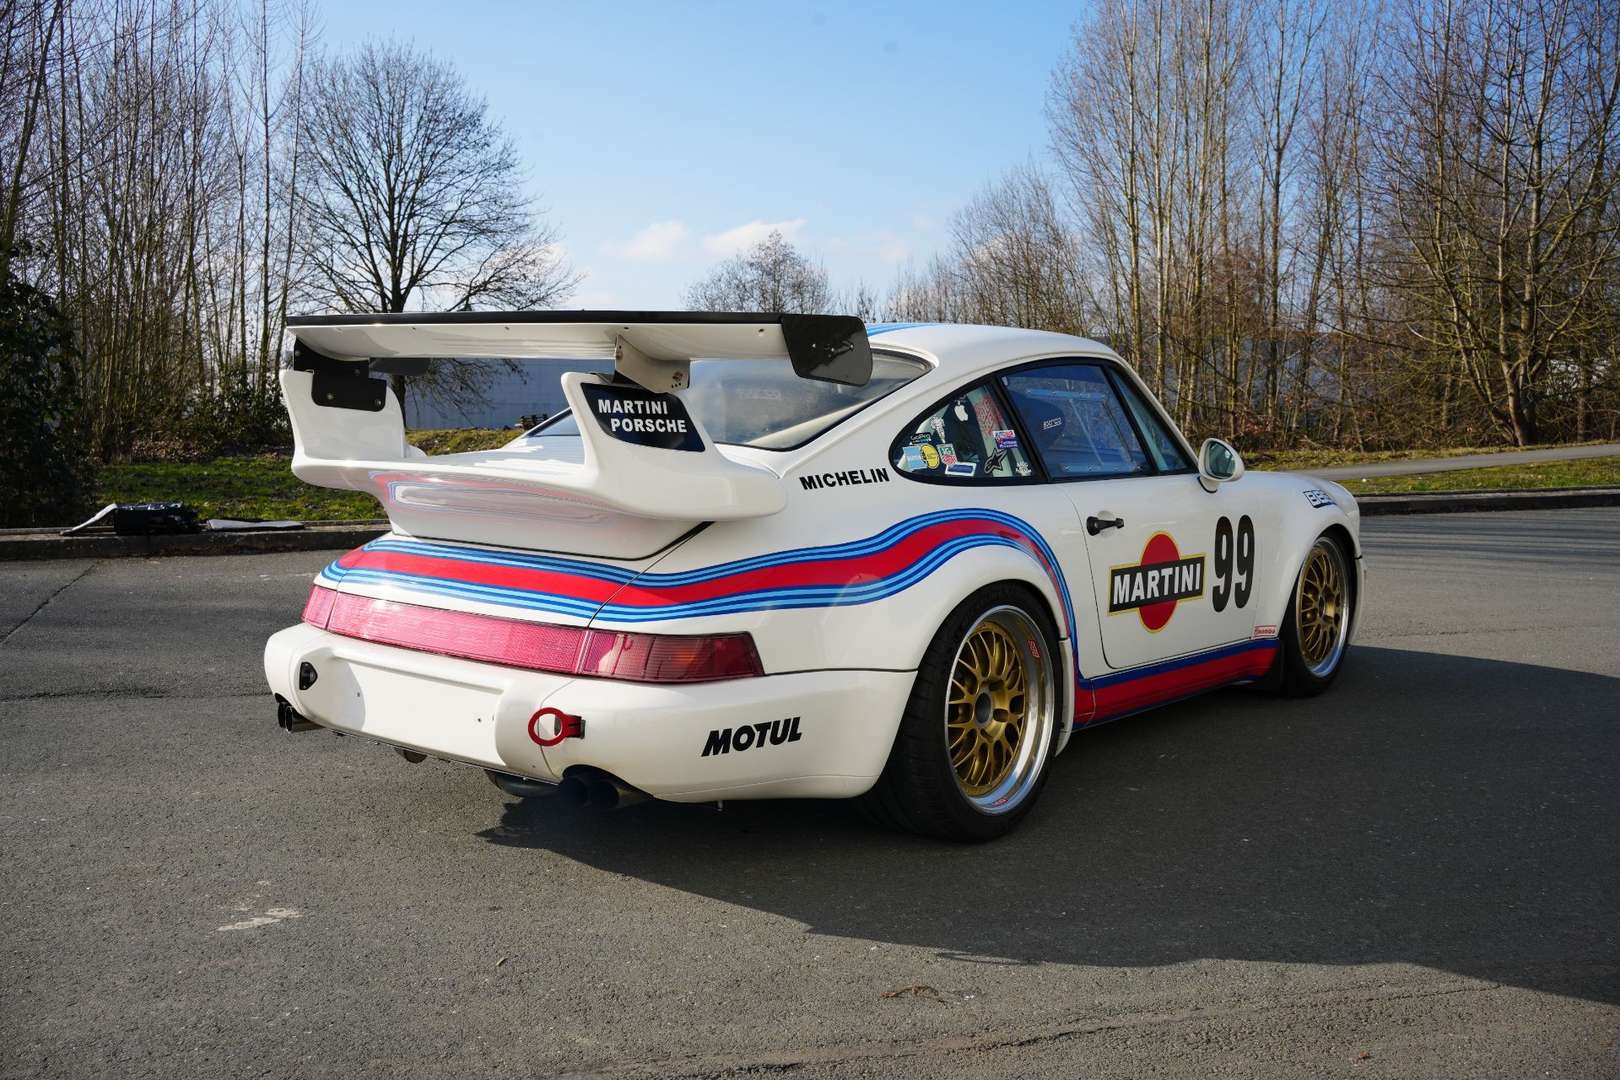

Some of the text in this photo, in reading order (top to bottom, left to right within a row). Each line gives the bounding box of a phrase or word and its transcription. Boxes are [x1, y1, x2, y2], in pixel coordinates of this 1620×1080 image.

[597, 399, 668, 414] MARTINI
[610, 418, 688, 432] PORSCHE
[799, 467, 890, 491] MICHELIN
[1211, 514, 1256, 614] 99
[1112, 562, 1202, 606] MARTINI
[701, 716, 803, 758] MOTUL
